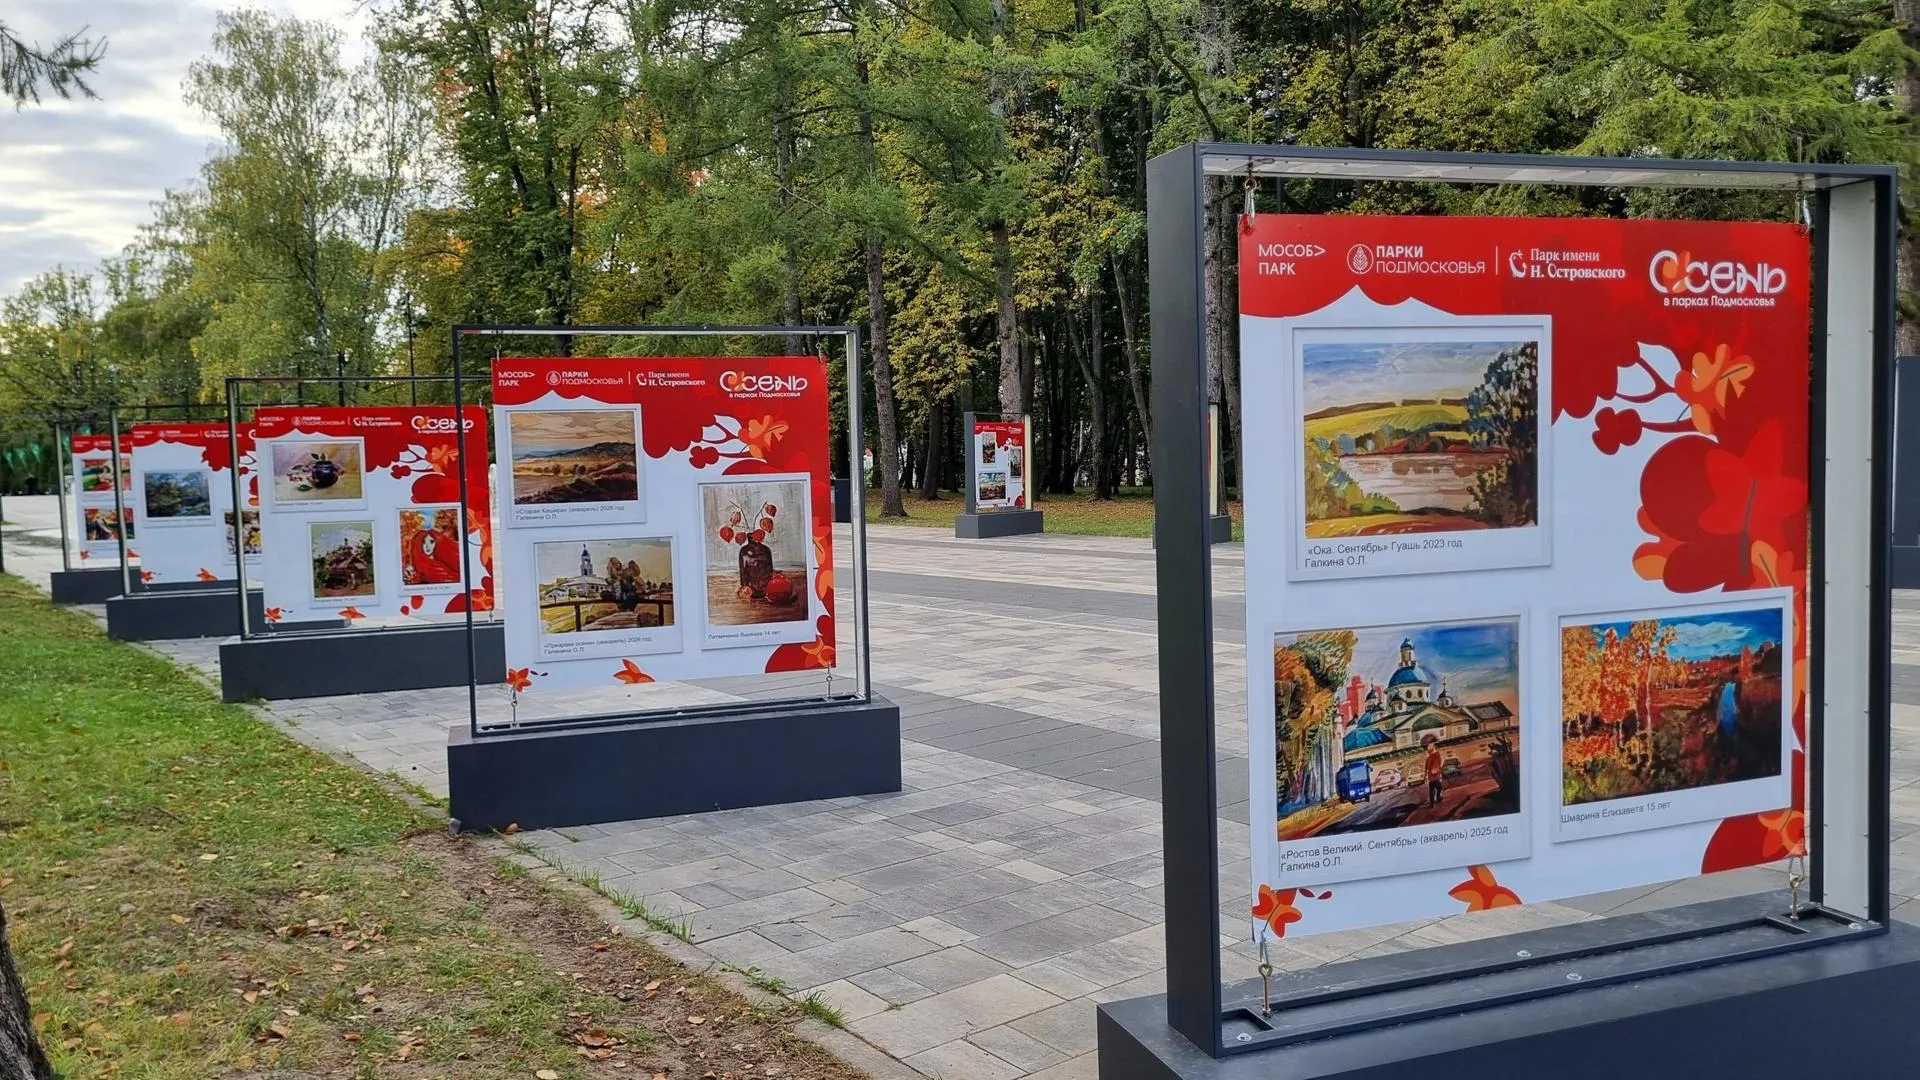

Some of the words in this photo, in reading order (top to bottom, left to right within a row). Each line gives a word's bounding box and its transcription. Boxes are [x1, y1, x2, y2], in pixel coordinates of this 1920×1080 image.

[1376, 246, 1424, 258] ПАРКИ
[1530, 249, 1560, 262] Парк
[1562, 251, 1600, 262] имени
[1259, 262, 1296, 275] ПАРК
[1376, 262, 1486, 274] ПОДМОСКОВЬЯ
[1530, 268, 1545, 279] Н.
[1549, 264, 1626, 281] Островского
[1663, 299, 1670, 307] в
[1672, 298, 1709, 308] парках
[1711, 295, 1775, 308] Подмосковья
[1308, 546, 1335, 556] «Ока.
[1337, 542, 1388, 554] Сентябрь»
[1391, 541, 1421, 552] Гуашь
[1424, 539, 1445, 549] 2023
[1448, 539, 1463, 549] год
[1305, 558, 1344, 568] Галкина
[1347, 556, 1367, 566] О.Л.
[1561, 811, 1600, 823] Шмарина
[1602, 806, 1644, 818] Елизавета
[1646, 802, 1656, 812] 15
[1657, 801, 1671, 809] лет
[1280, 848, 1320, 860] «Ростов
[1322, 843, 1364, 856] Великий.
[1368, 837, 1417, 850] Сентябрь»
[1420, 829, 1468, 845] (акварель)
[1470, 826, 1491, 837] 2025
[1494, 825, 1508, 836] год
[1280, 860, 1320, 873] Галкина
[1322, 856, 1344, 868] О.Л.
